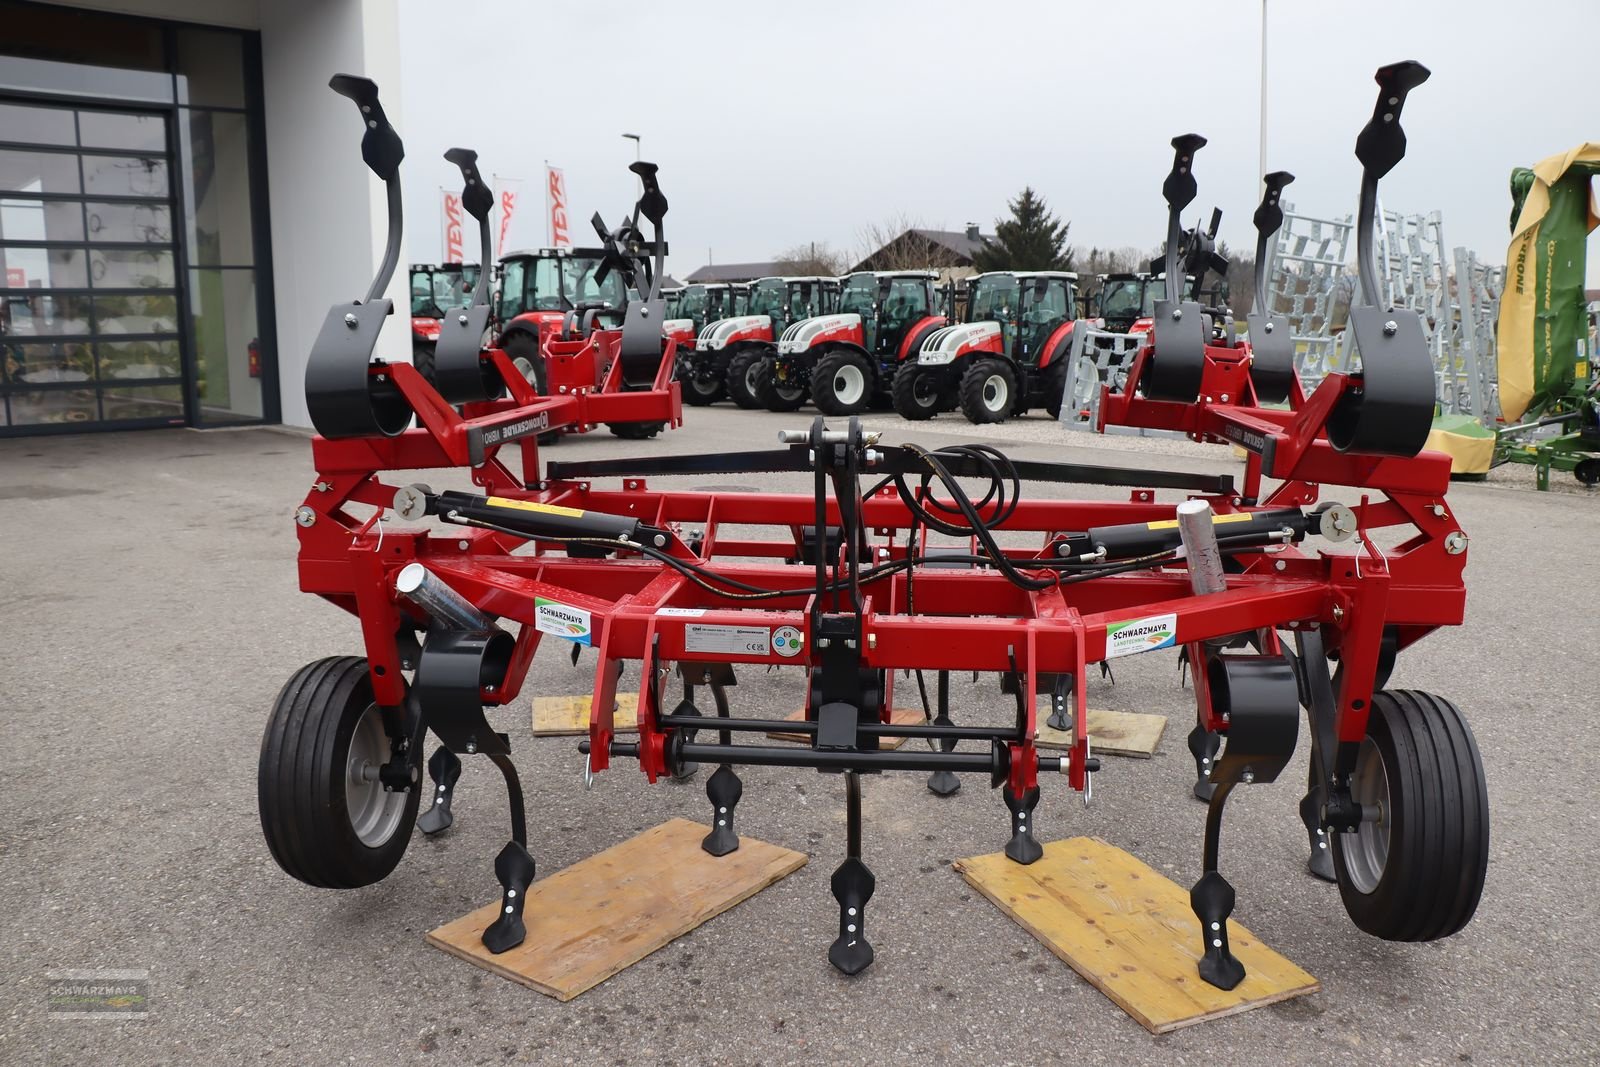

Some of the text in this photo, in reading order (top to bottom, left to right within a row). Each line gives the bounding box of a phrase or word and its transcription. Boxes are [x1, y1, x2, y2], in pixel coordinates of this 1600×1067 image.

[549, 171, 570, 248] TEYR
[540, 606, 583, 625] SCHWARZMAYR
[1113, 623, 1167, 640] SCHWARZMAYR
